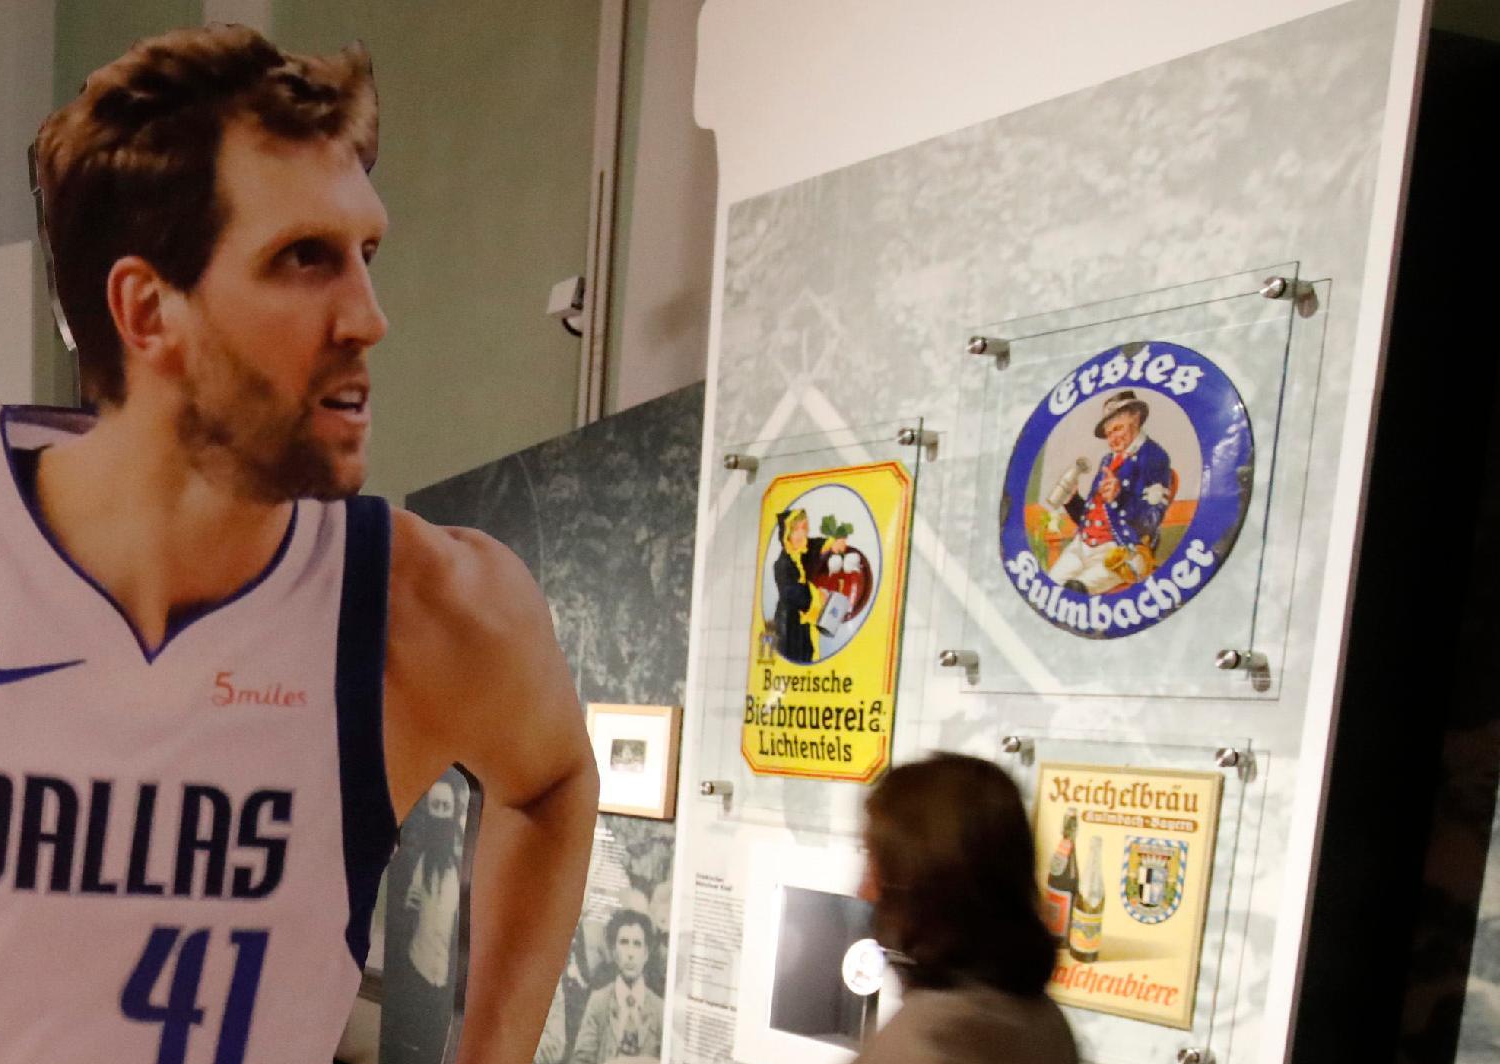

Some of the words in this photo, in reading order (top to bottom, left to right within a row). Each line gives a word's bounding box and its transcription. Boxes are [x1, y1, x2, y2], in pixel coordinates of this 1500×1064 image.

[1048, 345, 1204, 416] Erstes
[1005, 538, 1214, 630] Kulmbacher
[211, 671, 308, 707] 5miles
[762, 668, 853, 694] Bayerische
[744, 694, 866, 732] Bierbrauerei
[758, 730, 853, 762] Lichtenfels
[1049, 776, 1199, 813] Reichelbräu
[1052, 963, 1179, 1006] aschenbiere
